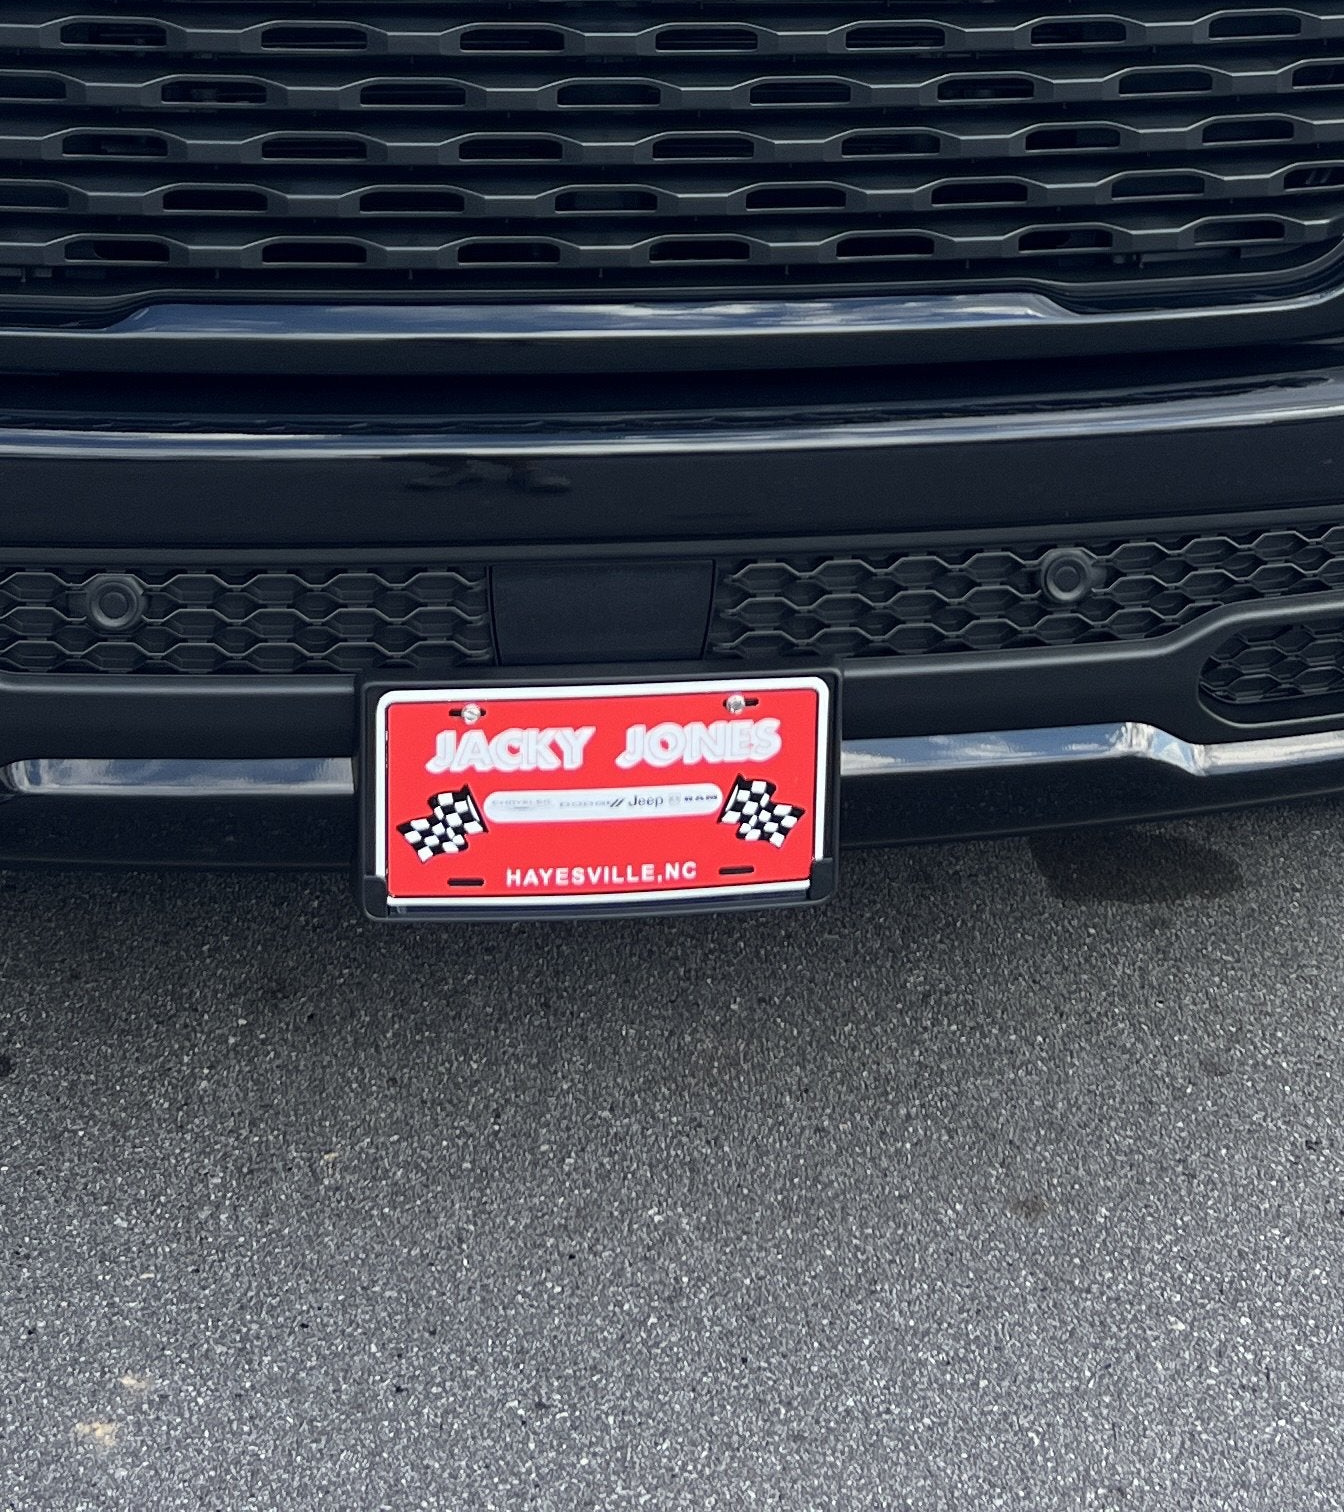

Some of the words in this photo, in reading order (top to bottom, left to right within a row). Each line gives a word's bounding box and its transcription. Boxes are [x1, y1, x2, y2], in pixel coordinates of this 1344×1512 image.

[425, 726, 596, 773] JACKY
[615, 718, 782, 769] JONES
[628, 794, 664, 808] Jeep
[506, 861, 697, 887] HAYESVILLE,NC
